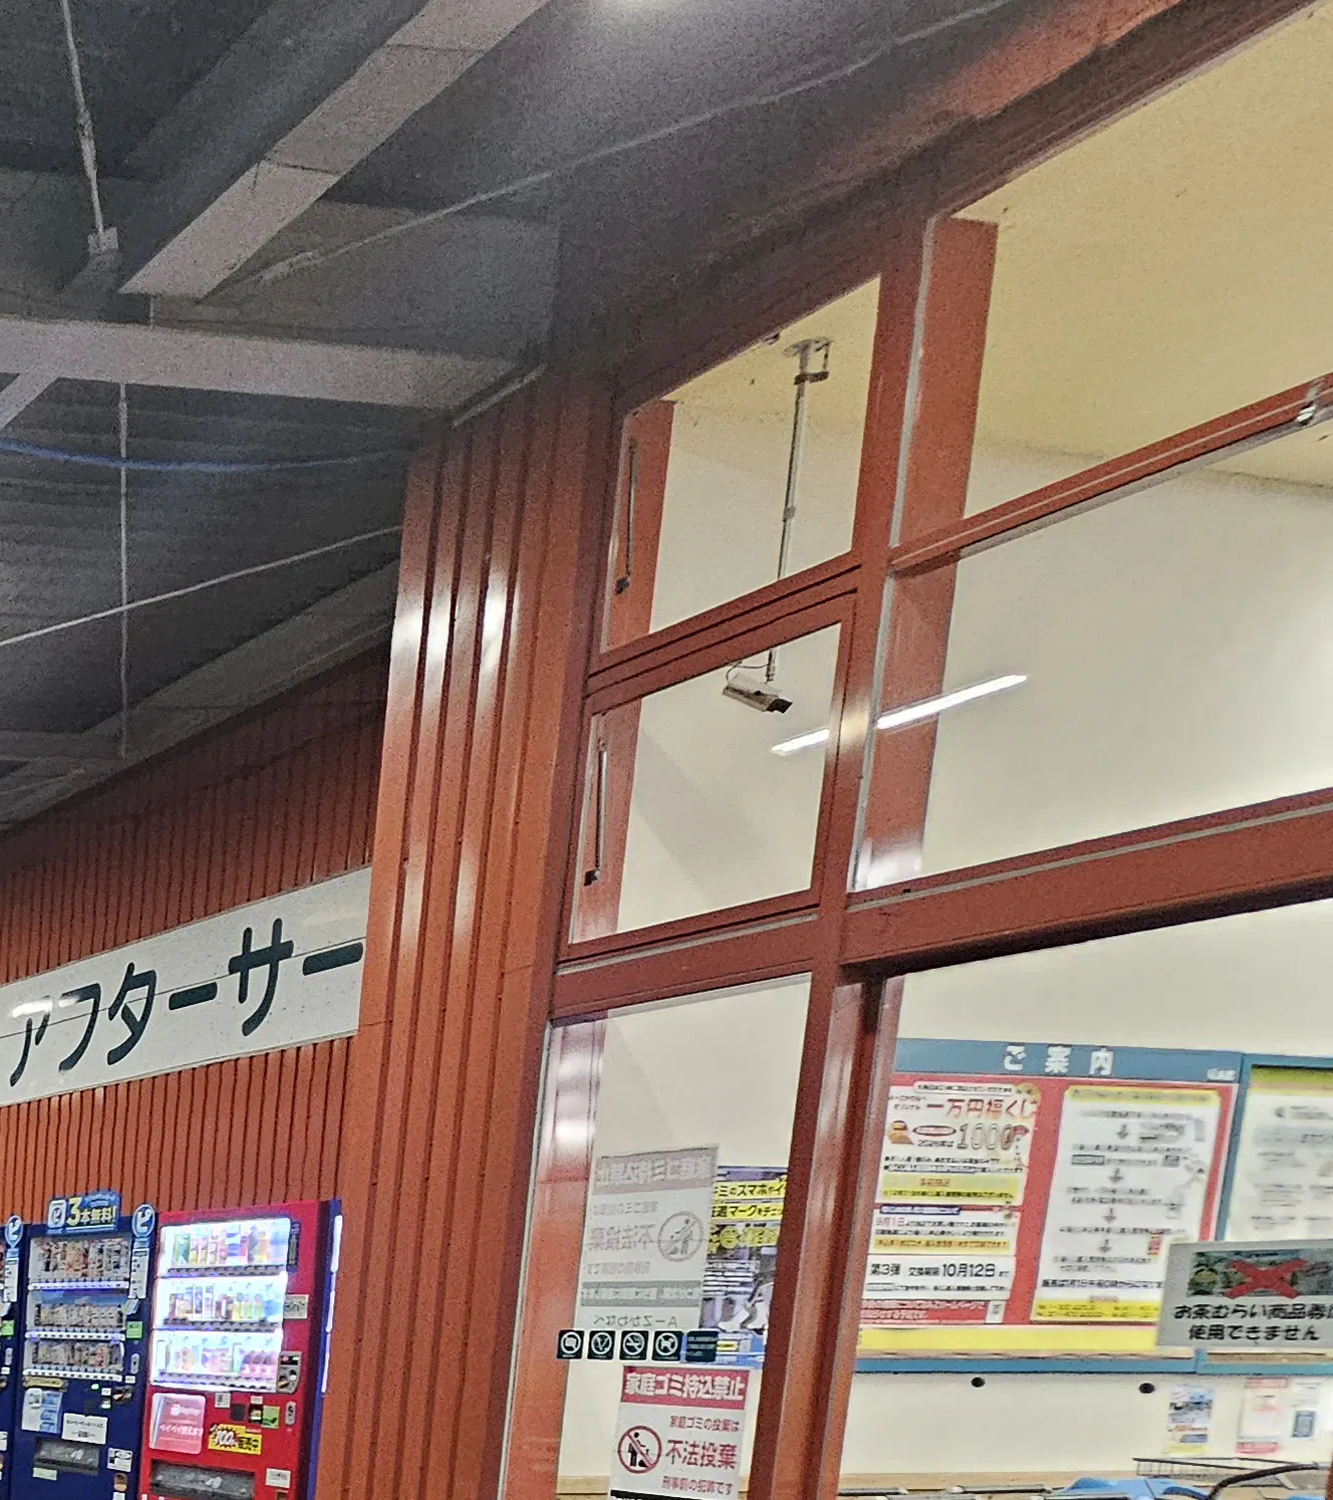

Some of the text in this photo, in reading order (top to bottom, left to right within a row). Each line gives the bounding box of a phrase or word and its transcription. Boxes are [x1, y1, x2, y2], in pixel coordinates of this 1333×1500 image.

[1003, 1044, 1113, 1076] ご案内
[1188, 1324, 1320, 1341] 使用できません
[625, 1372, 745, 1401] 家庭ゴミ持込禁止
[665, 1439, 738, 1470] 不法投棄
